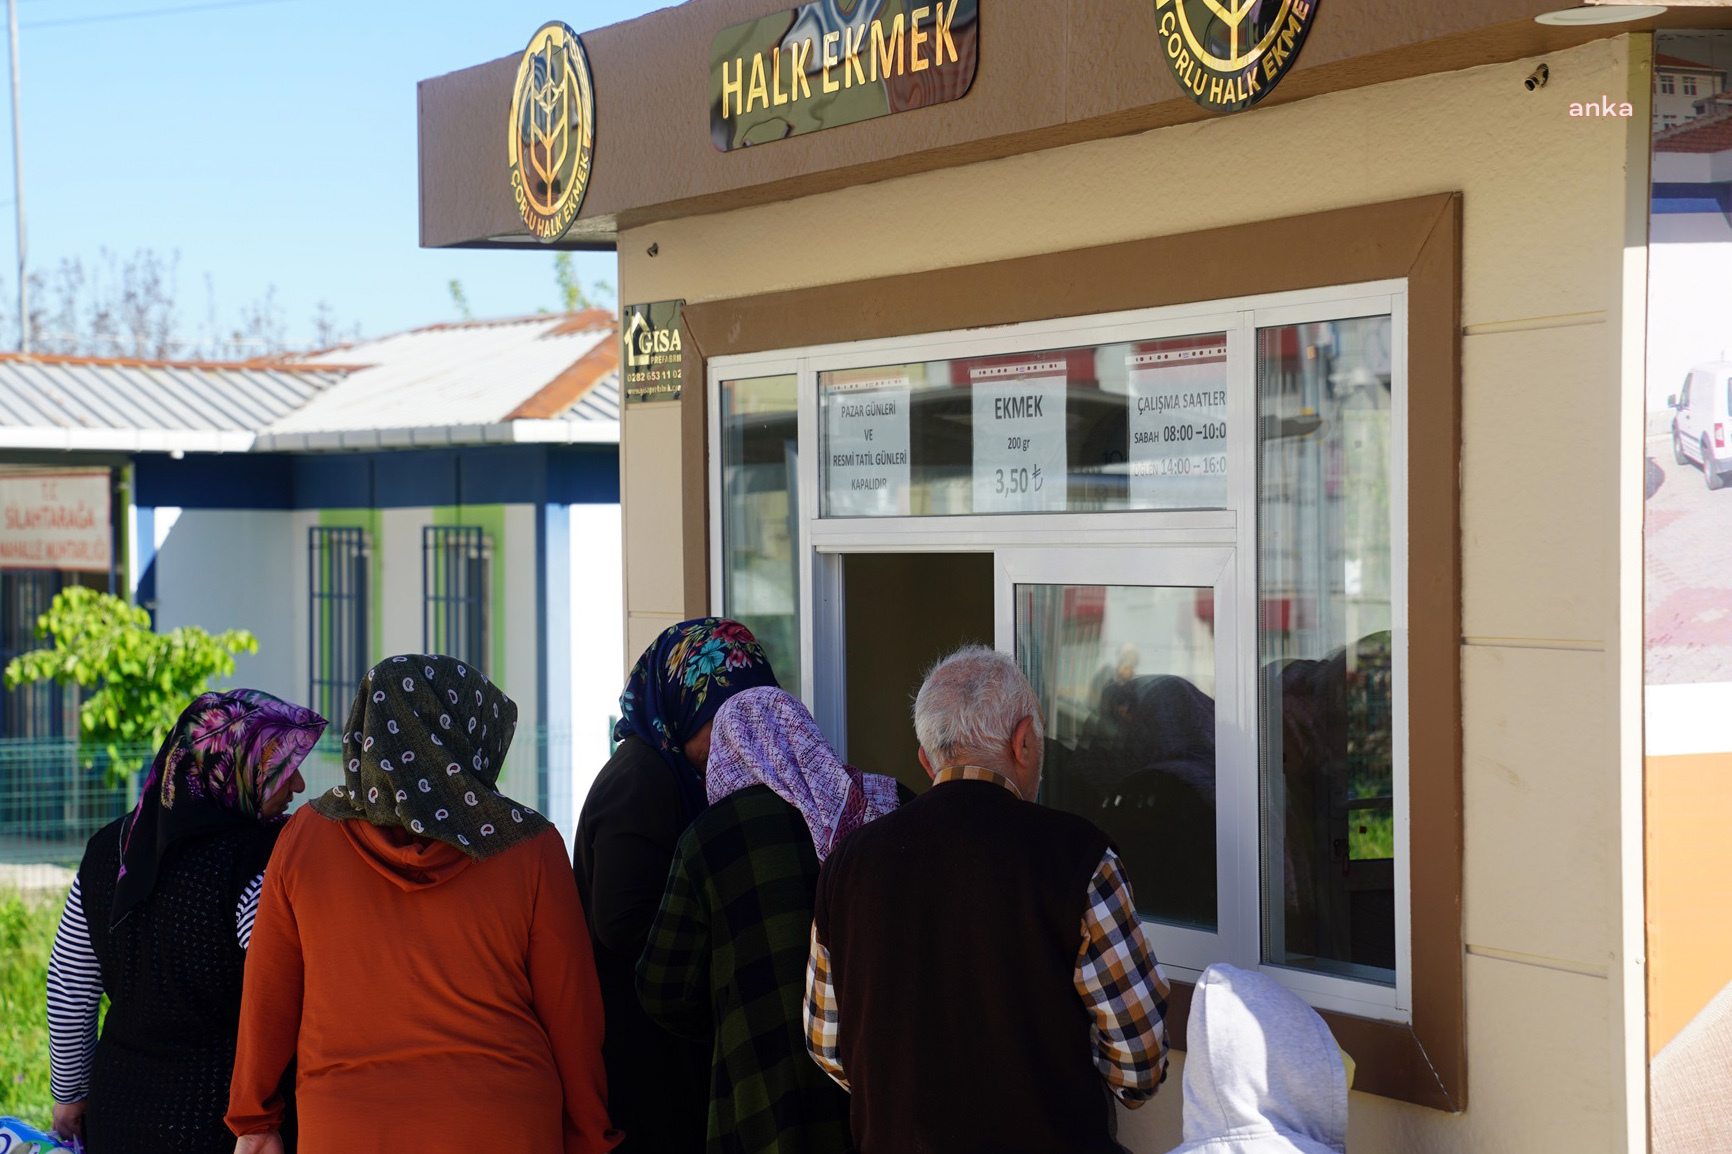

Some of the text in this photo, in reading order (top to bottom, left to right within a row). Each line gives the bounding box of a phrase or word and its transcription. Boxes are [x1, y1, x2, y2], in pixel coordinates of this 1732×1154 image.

[722, 0, 960, 119] HALK EKMEK
[1159, 0, 1310, 105] ÇORLU HALK EKME
[511, 152, 589, 238] ÇORLU HALK EKMEK
[638, 325, 682, 354] GİSA
[627, 372, 645, 382] 0282
[841, 400, 896, 418] PAZAR GÜNLERİ
[994, 395, 1043, 419] EKMEK
[1137, 391, 1226, 415] ÇALIŞMA SAATLER
[864, 429, 873, 441] VE
[1134, 431, 1160, 444] SABAH
[1163, 424, 1193, 442] 08:00
[1007, 437, 1030, 452] 200 gr
[833, 450, 907, 467] RESMİ TATİL GÜNLERİ
[1161, 457, 1191, 476] 14:00
[1203, 456, 1227, 474] 16:0
[851, 478, 887, 491] KAPALIDIR
[995, 467, 1028, 498] 3,50
